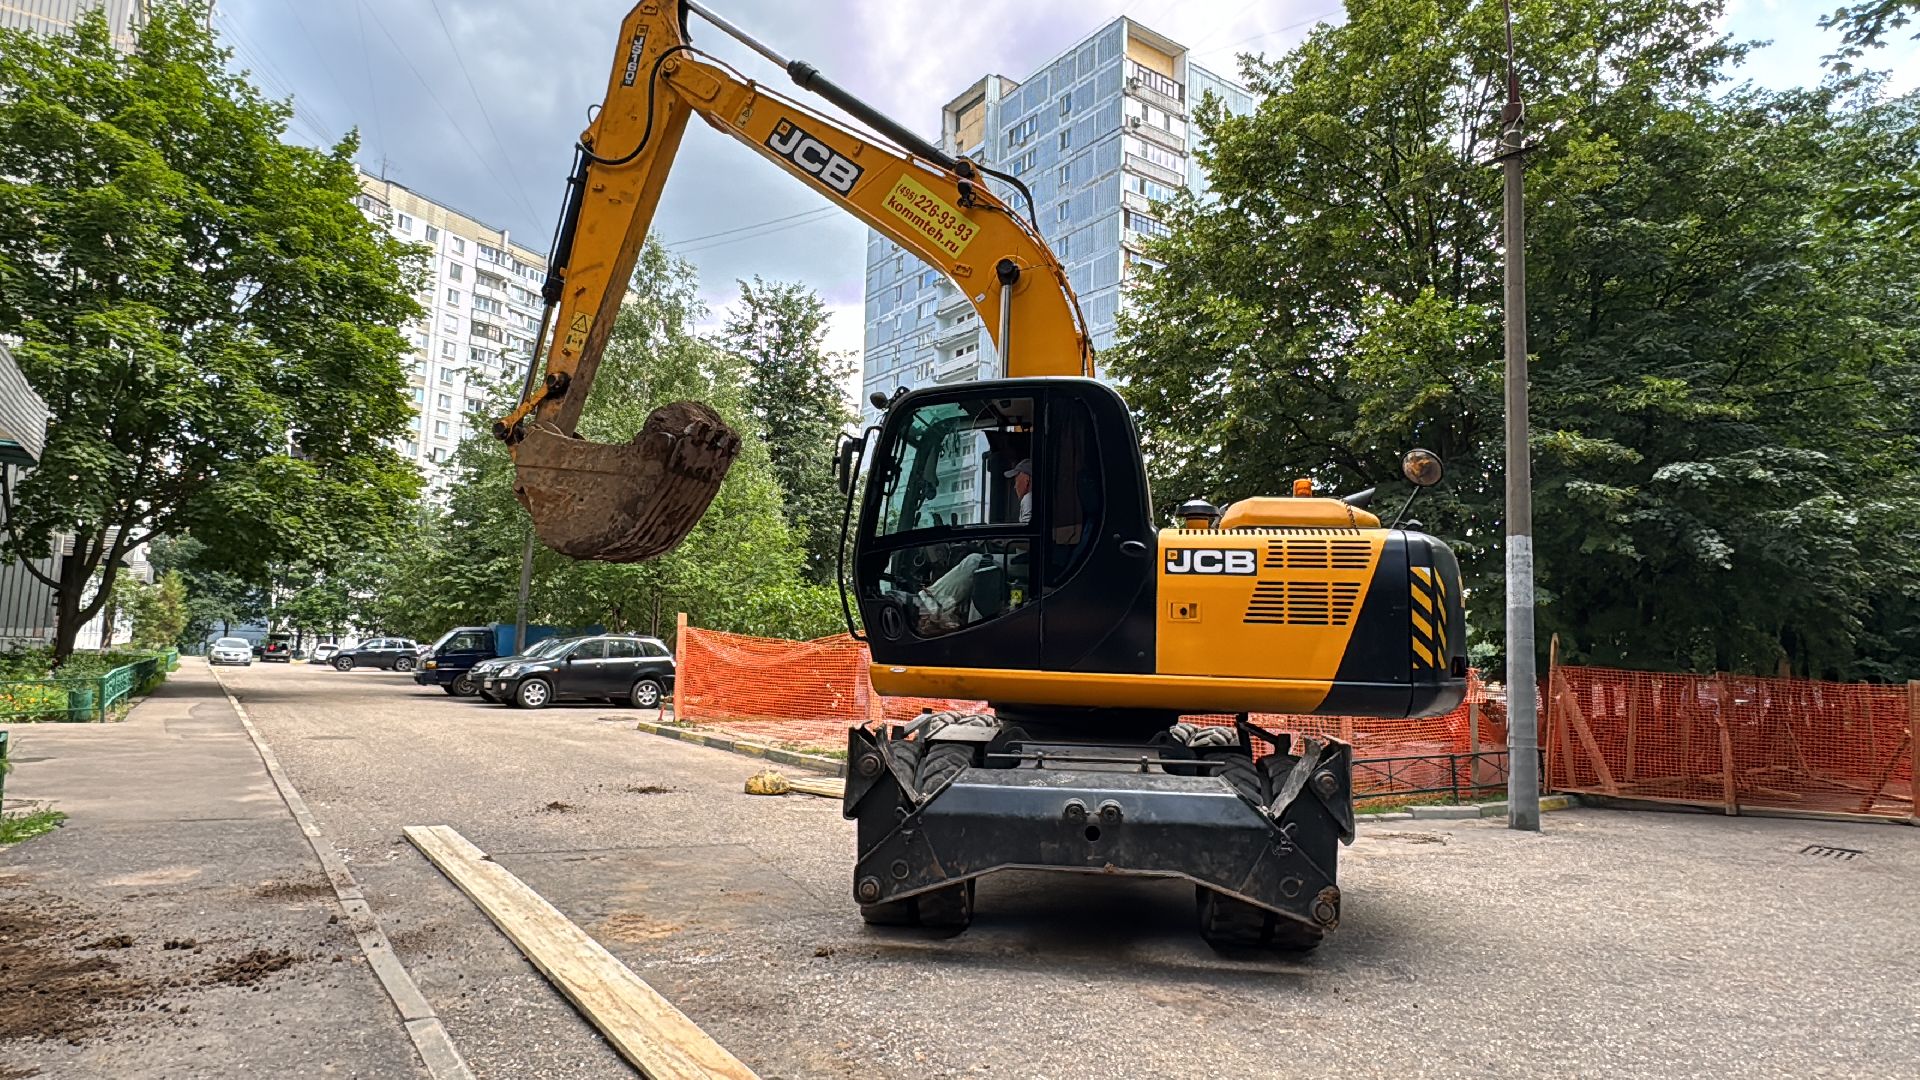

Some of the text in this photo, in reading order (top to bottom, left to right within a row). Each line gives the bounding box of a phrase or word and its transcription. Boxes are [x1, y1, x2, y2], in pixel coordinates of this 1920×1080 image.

[769, 129, 859, 192] JCB
[887, 195, 960, 254] kommteh.ru
[1167, 549, 1255, 574] JCB
